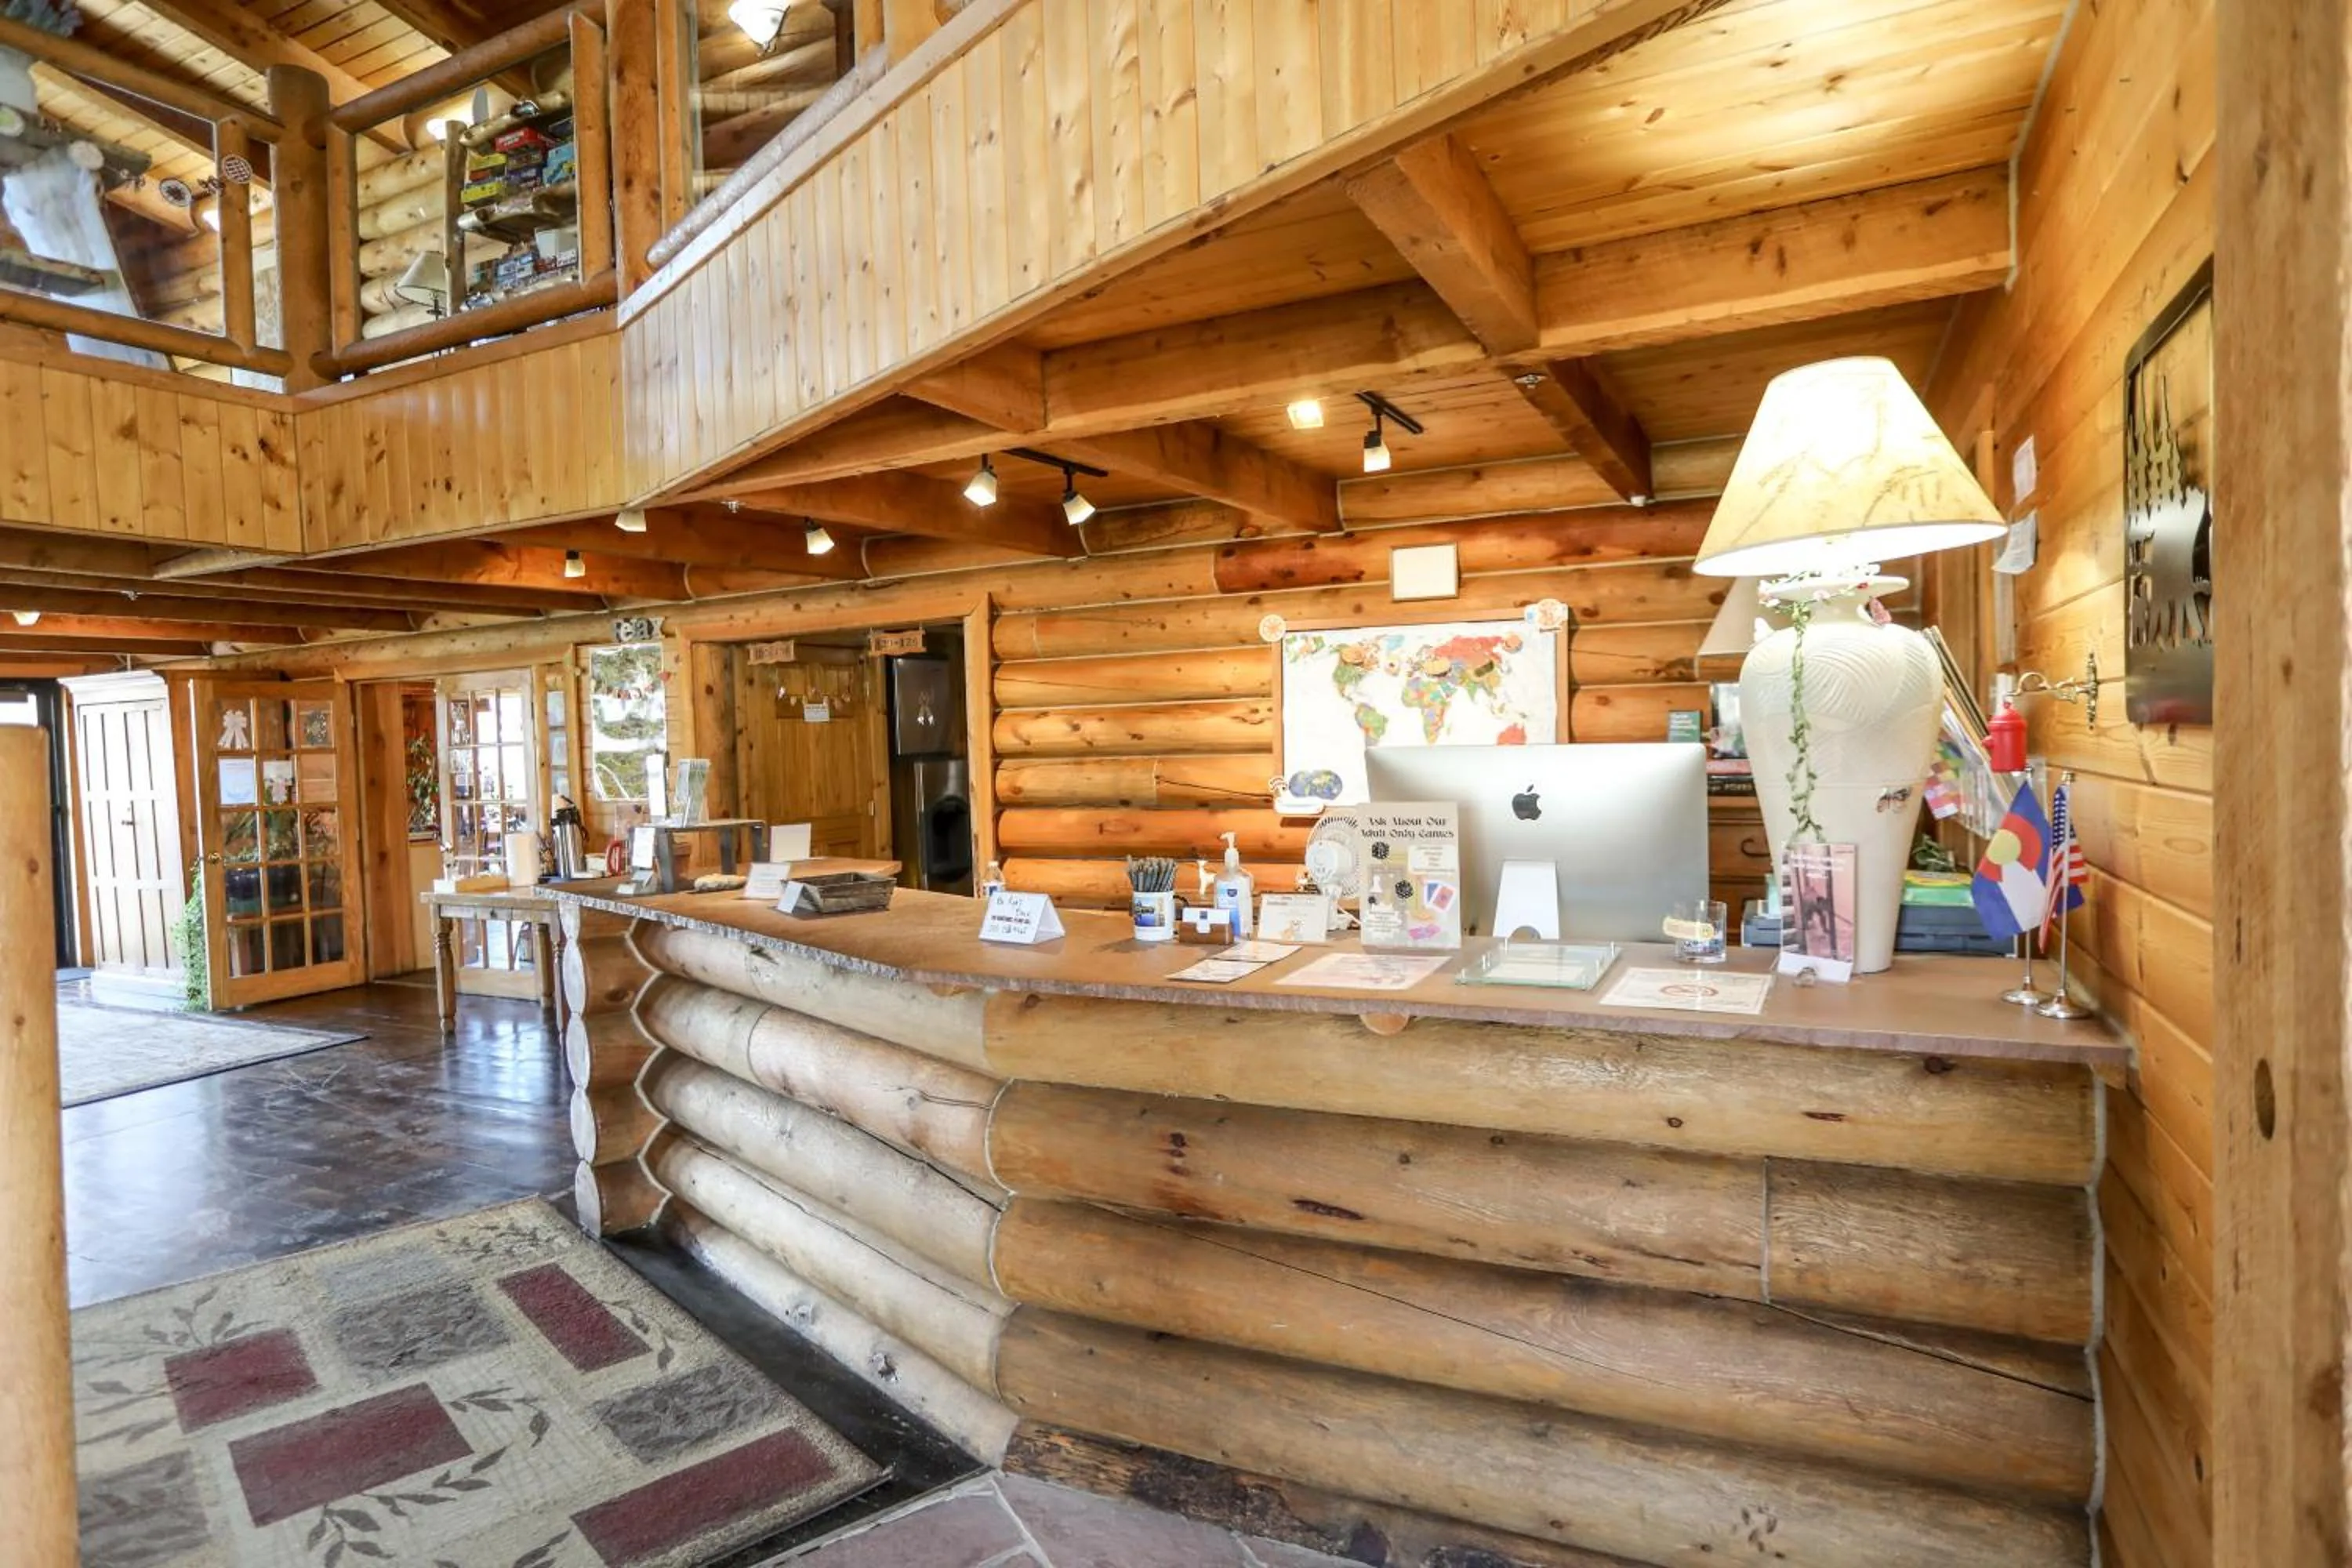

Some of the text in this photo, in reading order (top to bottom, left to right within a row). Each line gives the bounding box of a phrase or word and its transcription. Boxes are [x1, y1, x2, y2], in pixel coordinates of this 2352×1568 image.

[1369, 816, 1446, 826] Ask About Our
[1361, 829, 1455, 840] Adult Only Games
